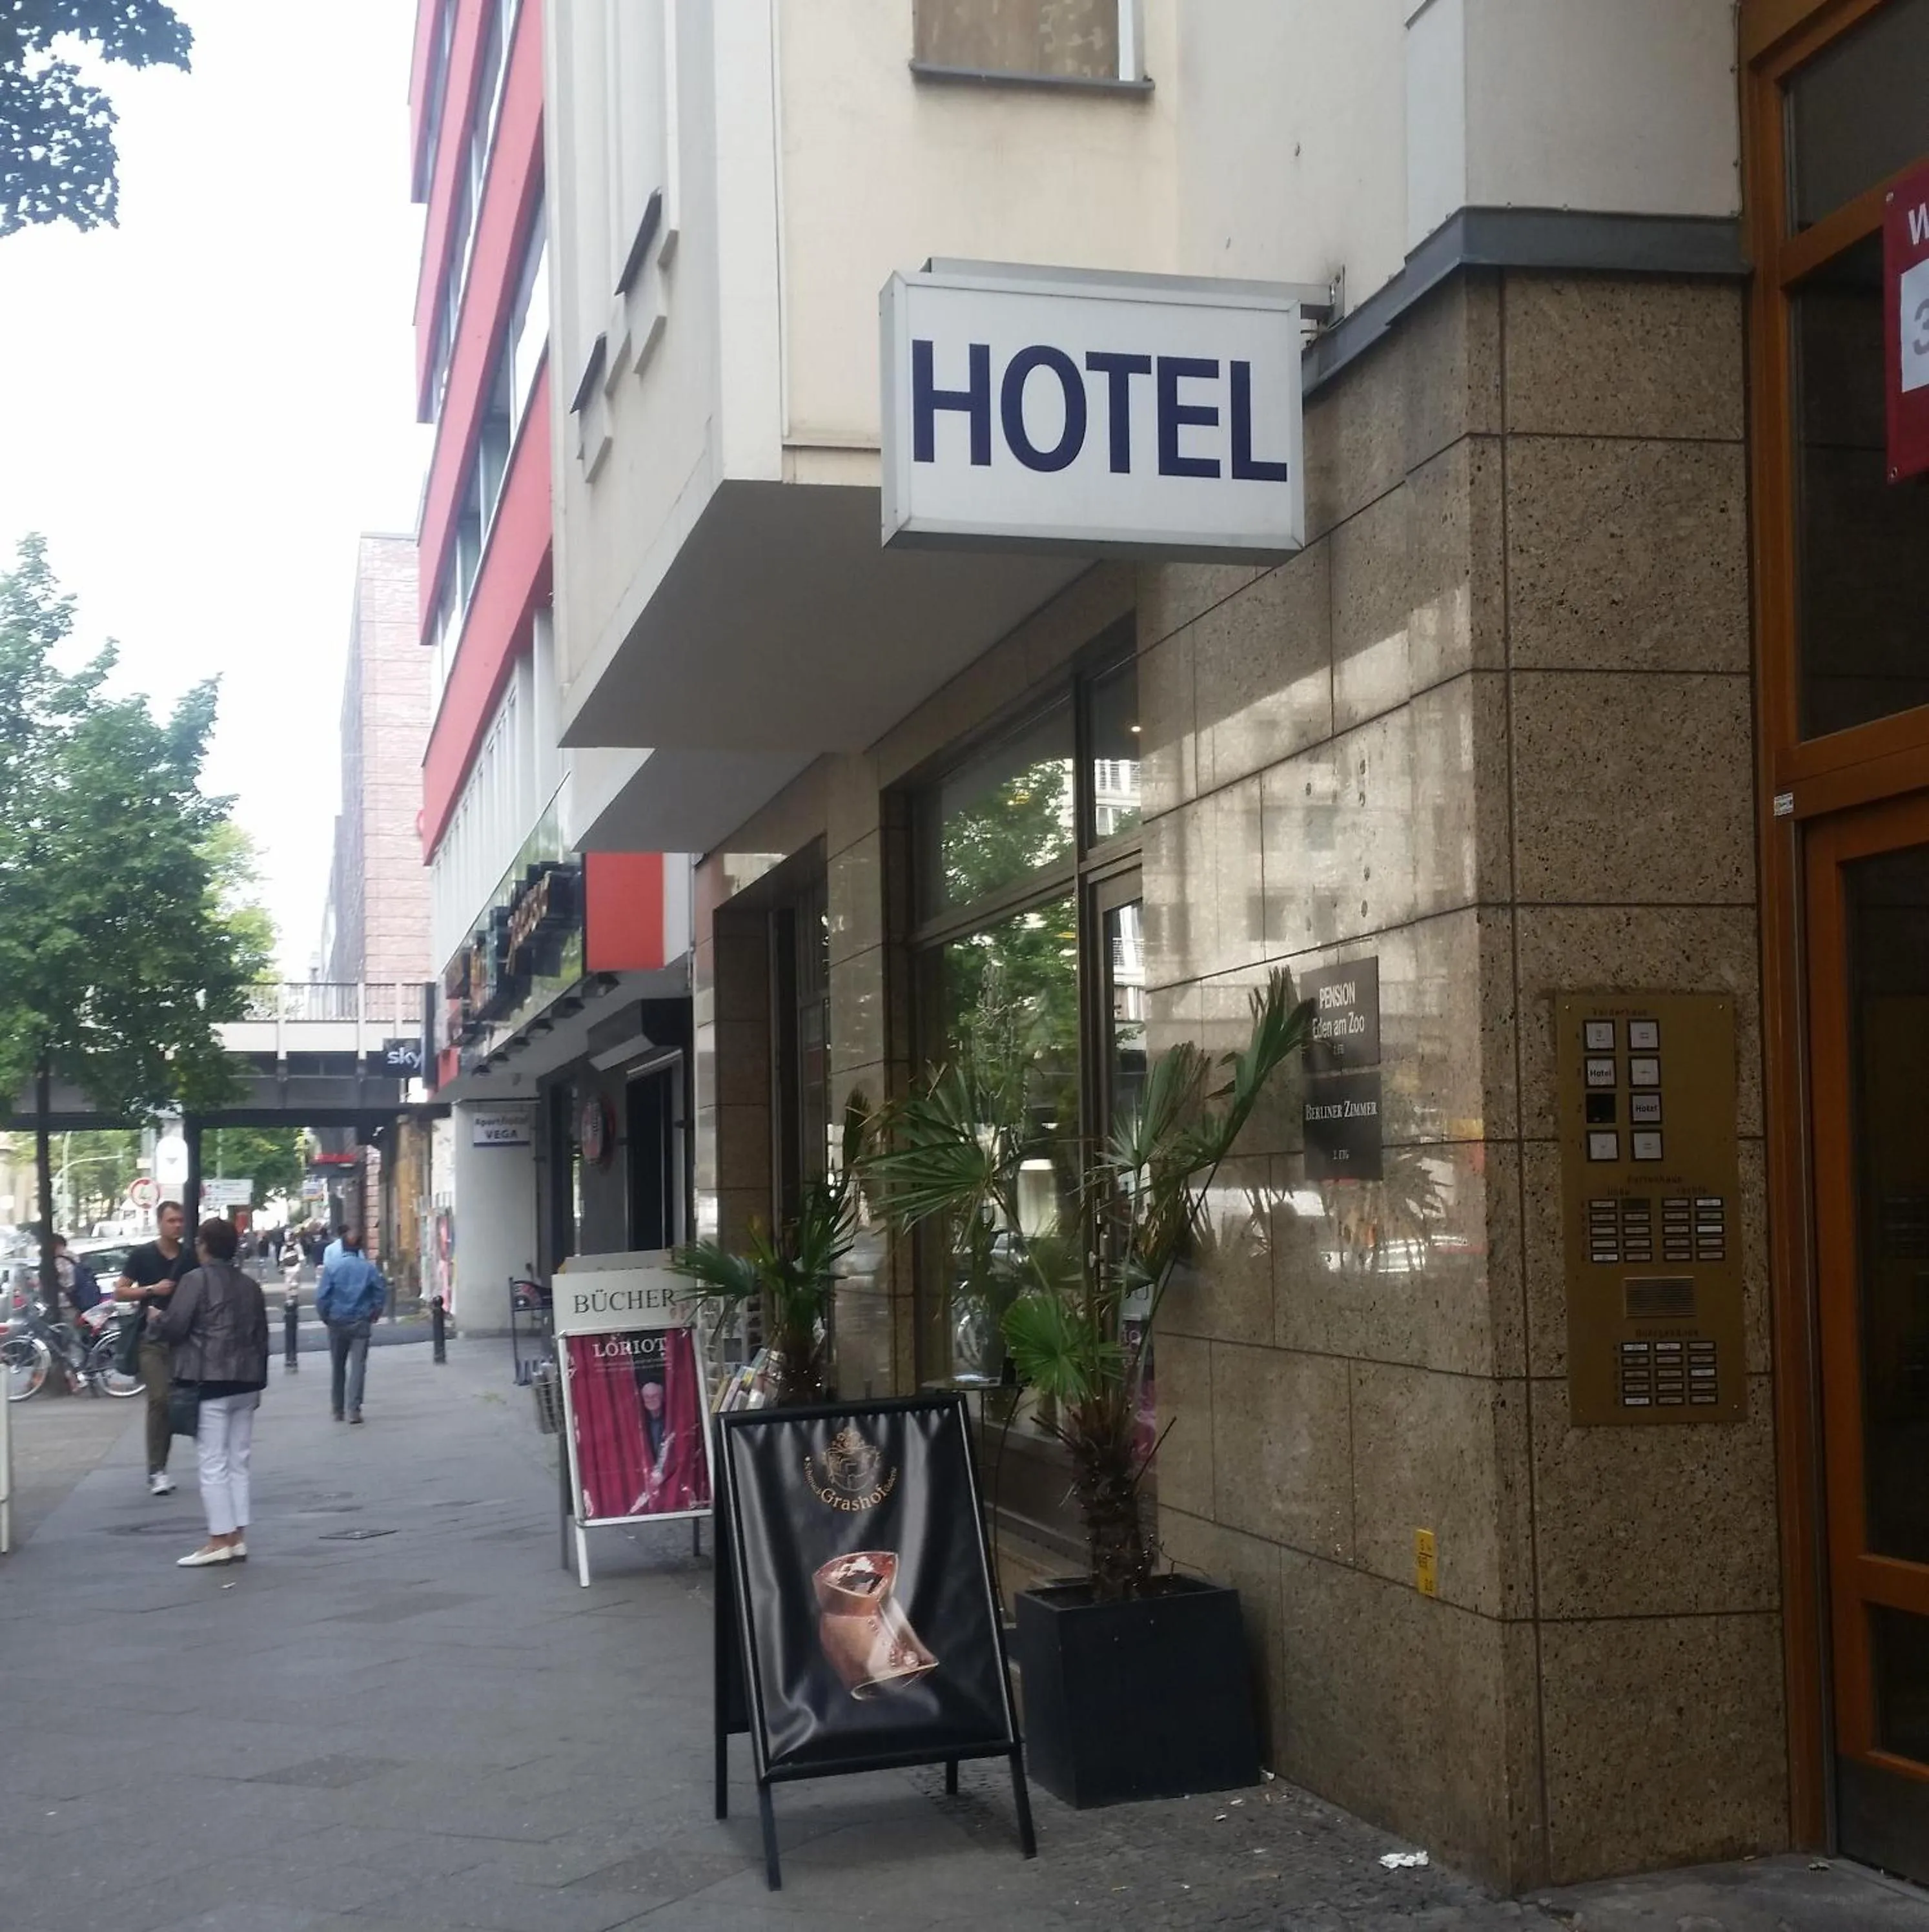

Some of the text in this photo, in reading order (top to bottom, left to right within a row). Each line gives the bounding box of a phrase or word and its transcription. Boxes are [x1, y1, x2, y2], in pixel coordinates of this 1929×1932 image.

[912, 339, 1288, 482] HOTEL
[1319, 981, 1356, 1009] PENSION
[1312, 1012, 1365, 1039] Eden am Zoo
[387, 1047, 423, 1069] sky
[1590, 1069, 1612, 1077] Hotel
[1305, 1100, 1378, 1120] BERLINER ZIMMER
[485, 1129, 518, 1139] VEGA
[574, 1289, 677, 1313] BÜCHER
[592, 1337, 666, 1357] LORIOT
[821, 1483, 887, 1511] Grashof
